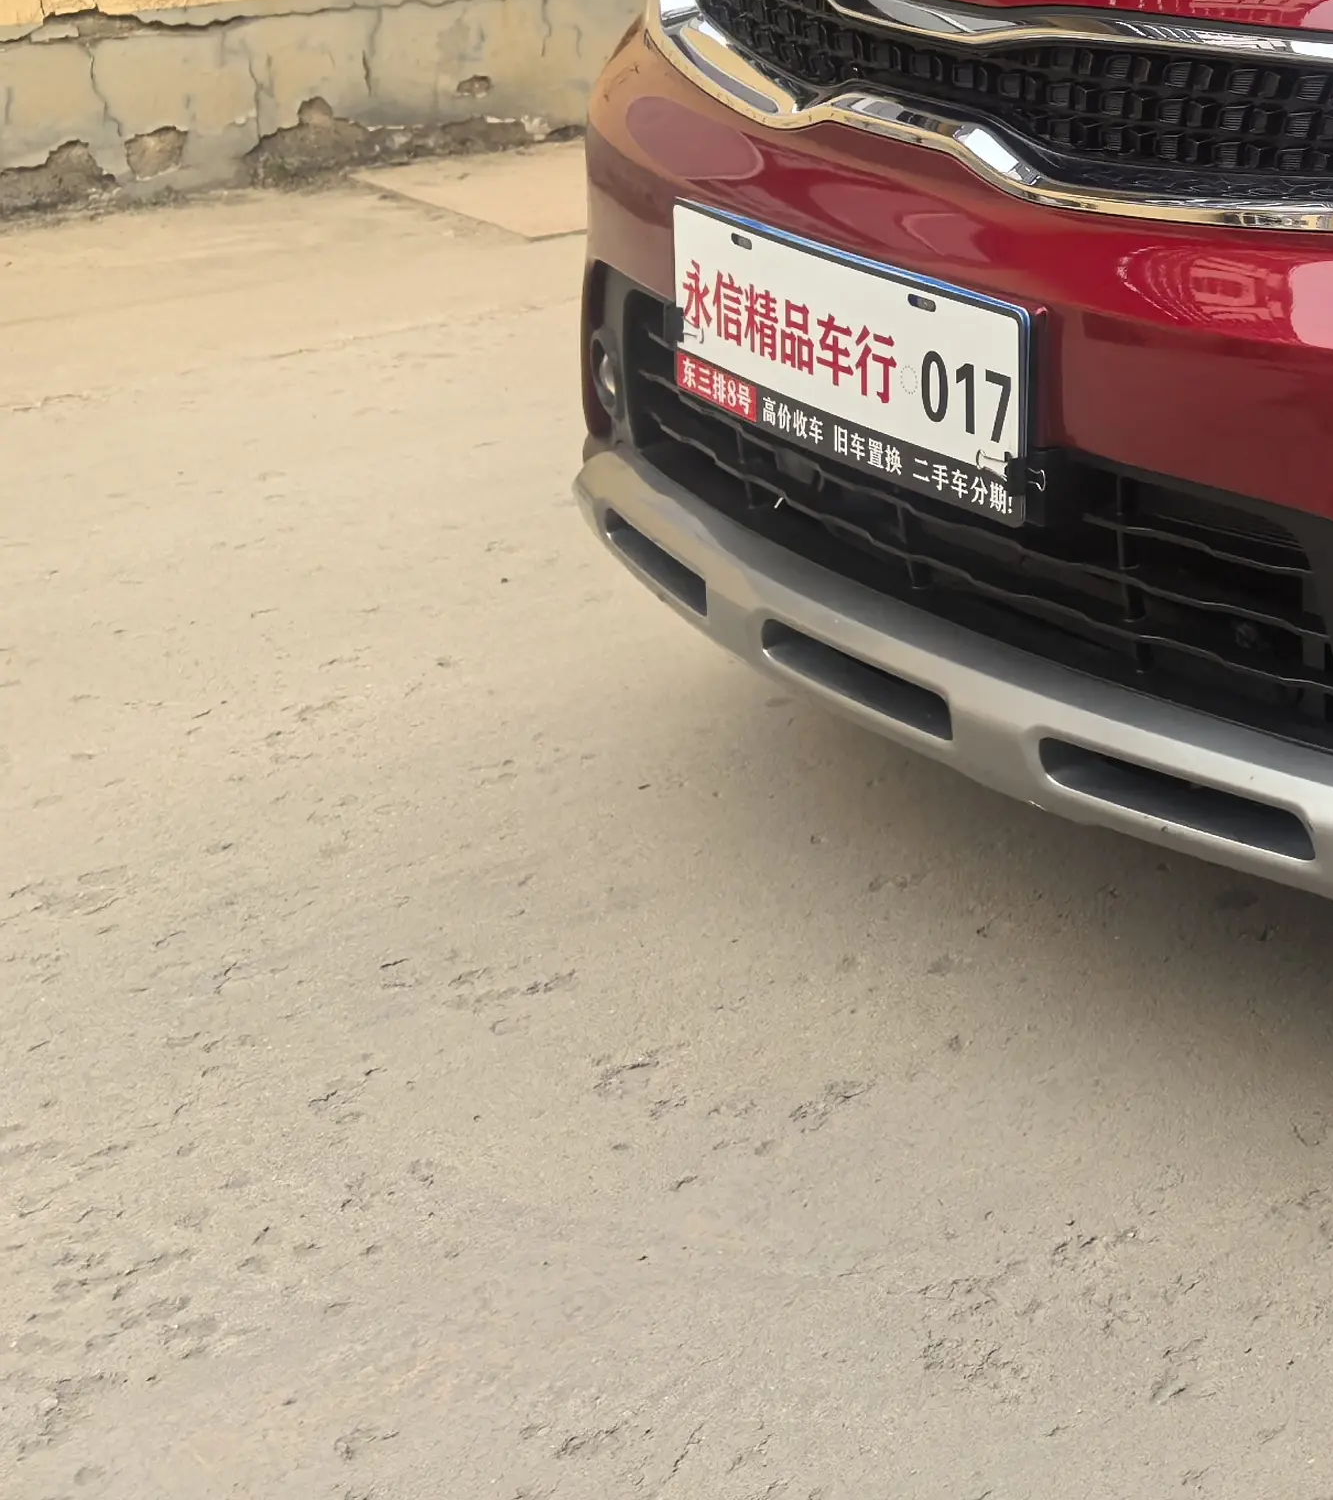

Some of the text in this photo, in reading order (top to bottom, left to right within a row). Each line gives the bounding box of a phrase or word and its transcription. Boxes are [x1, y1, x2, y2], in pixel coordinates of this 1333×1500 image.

[681, 258, 1013, 444] 永信精品车行 017
[682, 357, 1013, 515] 东三排8号 高价收车 旧车置换 二手车分期!
